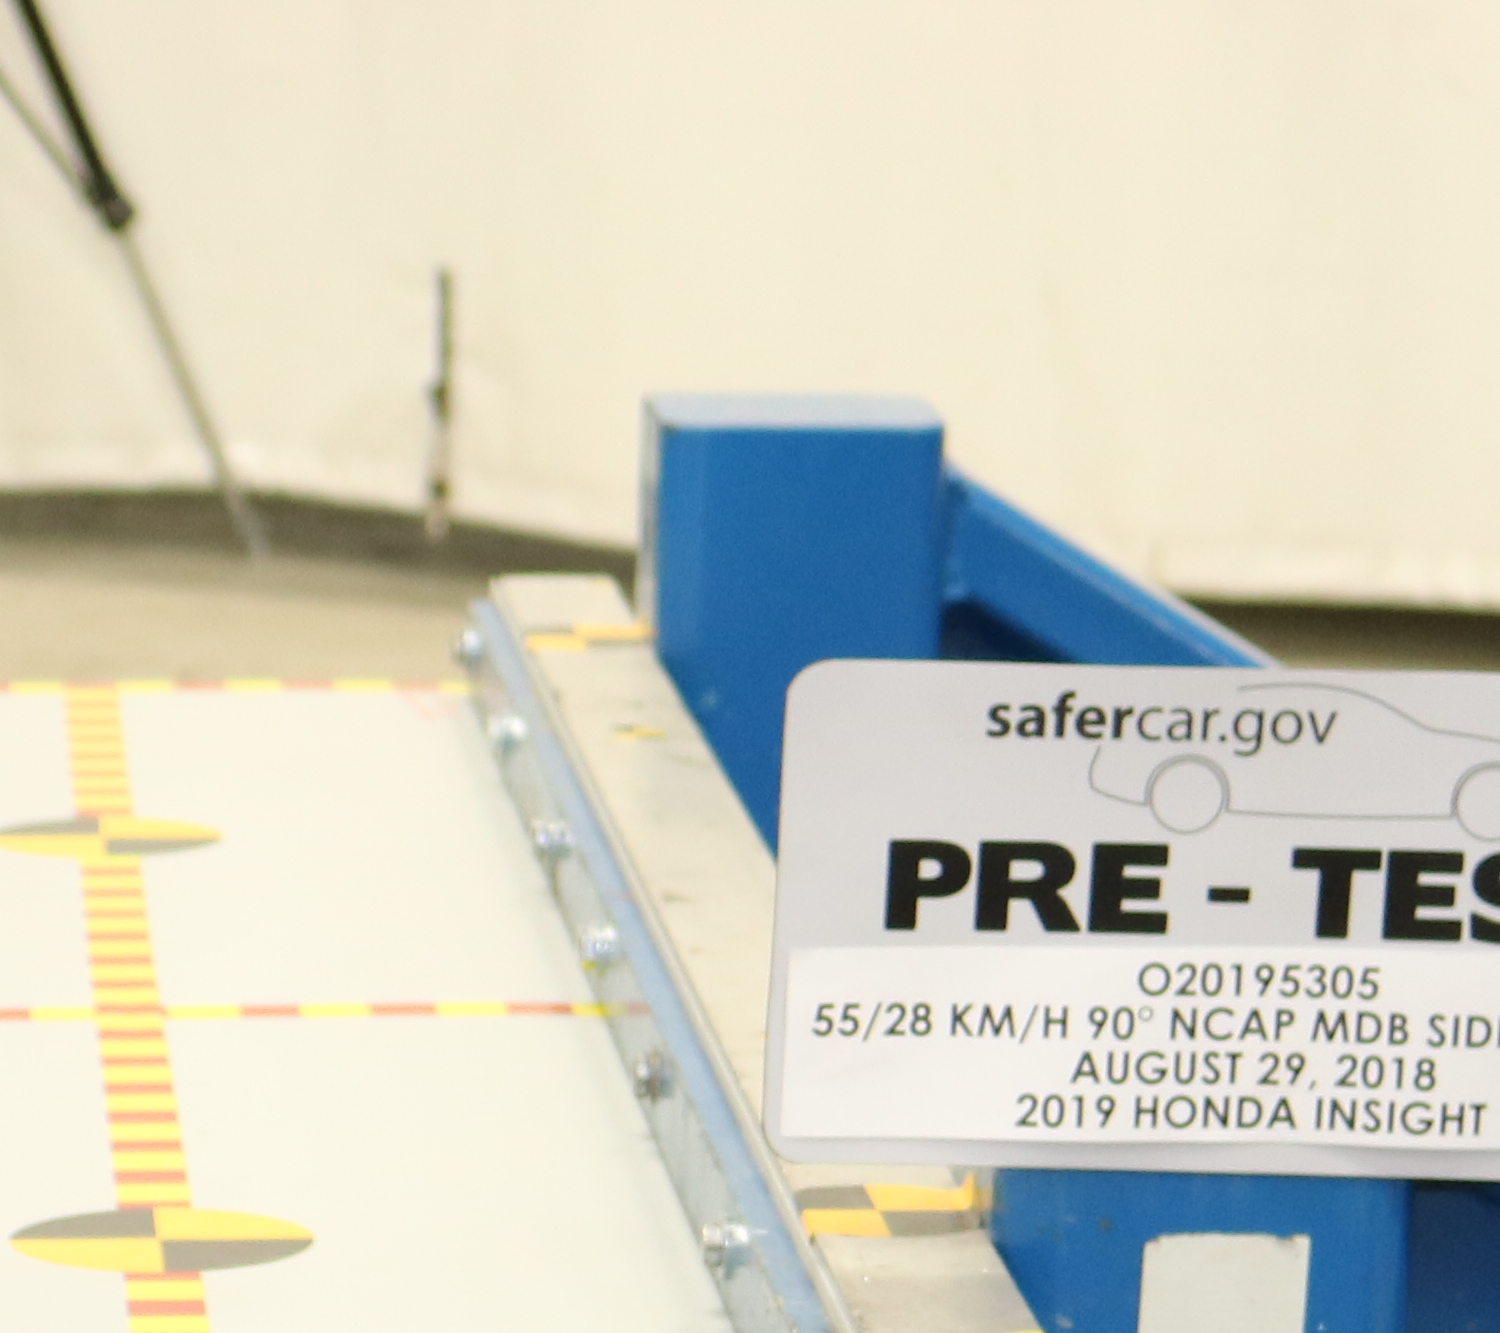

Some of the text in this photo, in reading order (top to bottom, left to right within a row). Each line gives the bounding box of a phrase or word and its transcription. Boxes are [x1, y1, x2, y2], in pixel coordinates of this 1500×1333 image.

[988, 692, 1335, 755] safercar.gov
[885, 840, 1169, 935] PRE
[814, 1003, 932, 1039] 55/28
[951, 1004, 1068, 1041] KM/H
[1171, 1007, 1295, 1041] NCAP
[1311, 1010, 1409, 1045] MDB
[1072, 1051, 1436, 1091] AUGUST 29, 2018
[1017, 1094, 1486, 1135] 2019 HONDA INSIGHT
